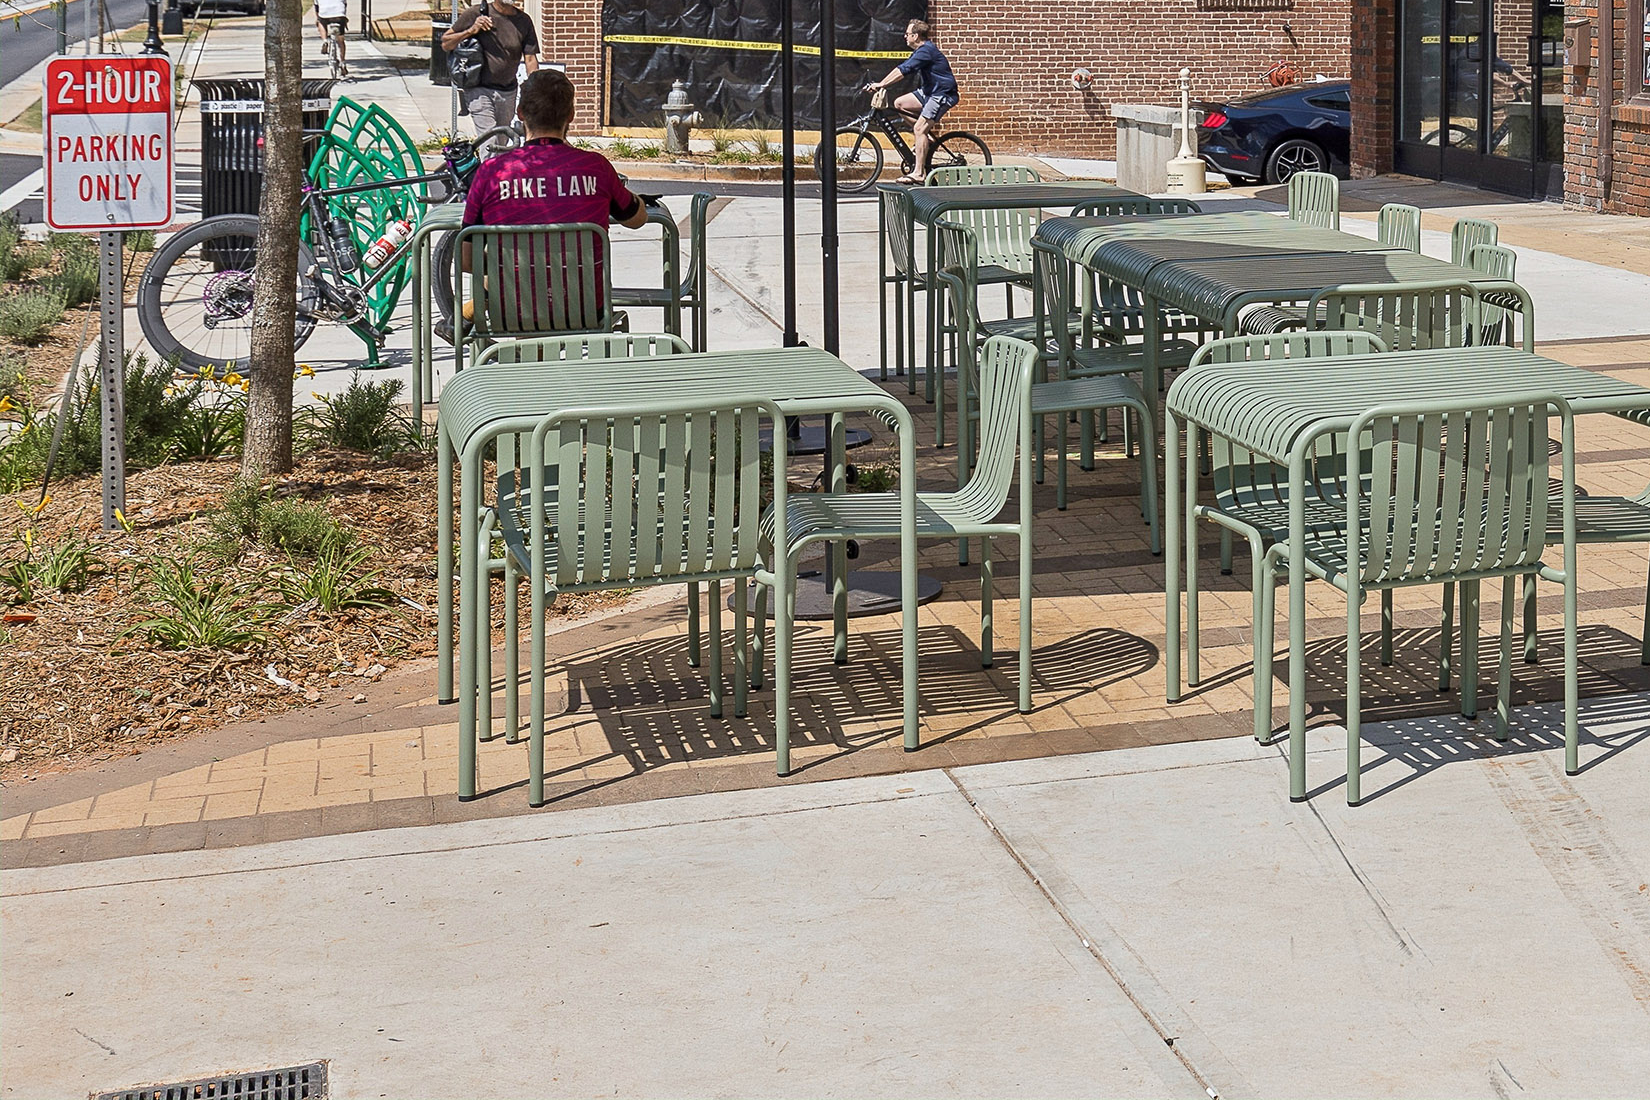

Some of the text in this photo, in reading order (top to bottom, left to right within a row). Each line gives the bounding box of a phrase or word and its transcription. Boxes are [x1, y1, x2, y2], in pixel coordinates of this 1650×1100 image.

[57, 71, 161, 106] 2-HOUR
[57, 134, 163, 164] PARKING
[78, 173, 141, 202] ONLY
[499, 175, 597, 200] BIKE LAW
